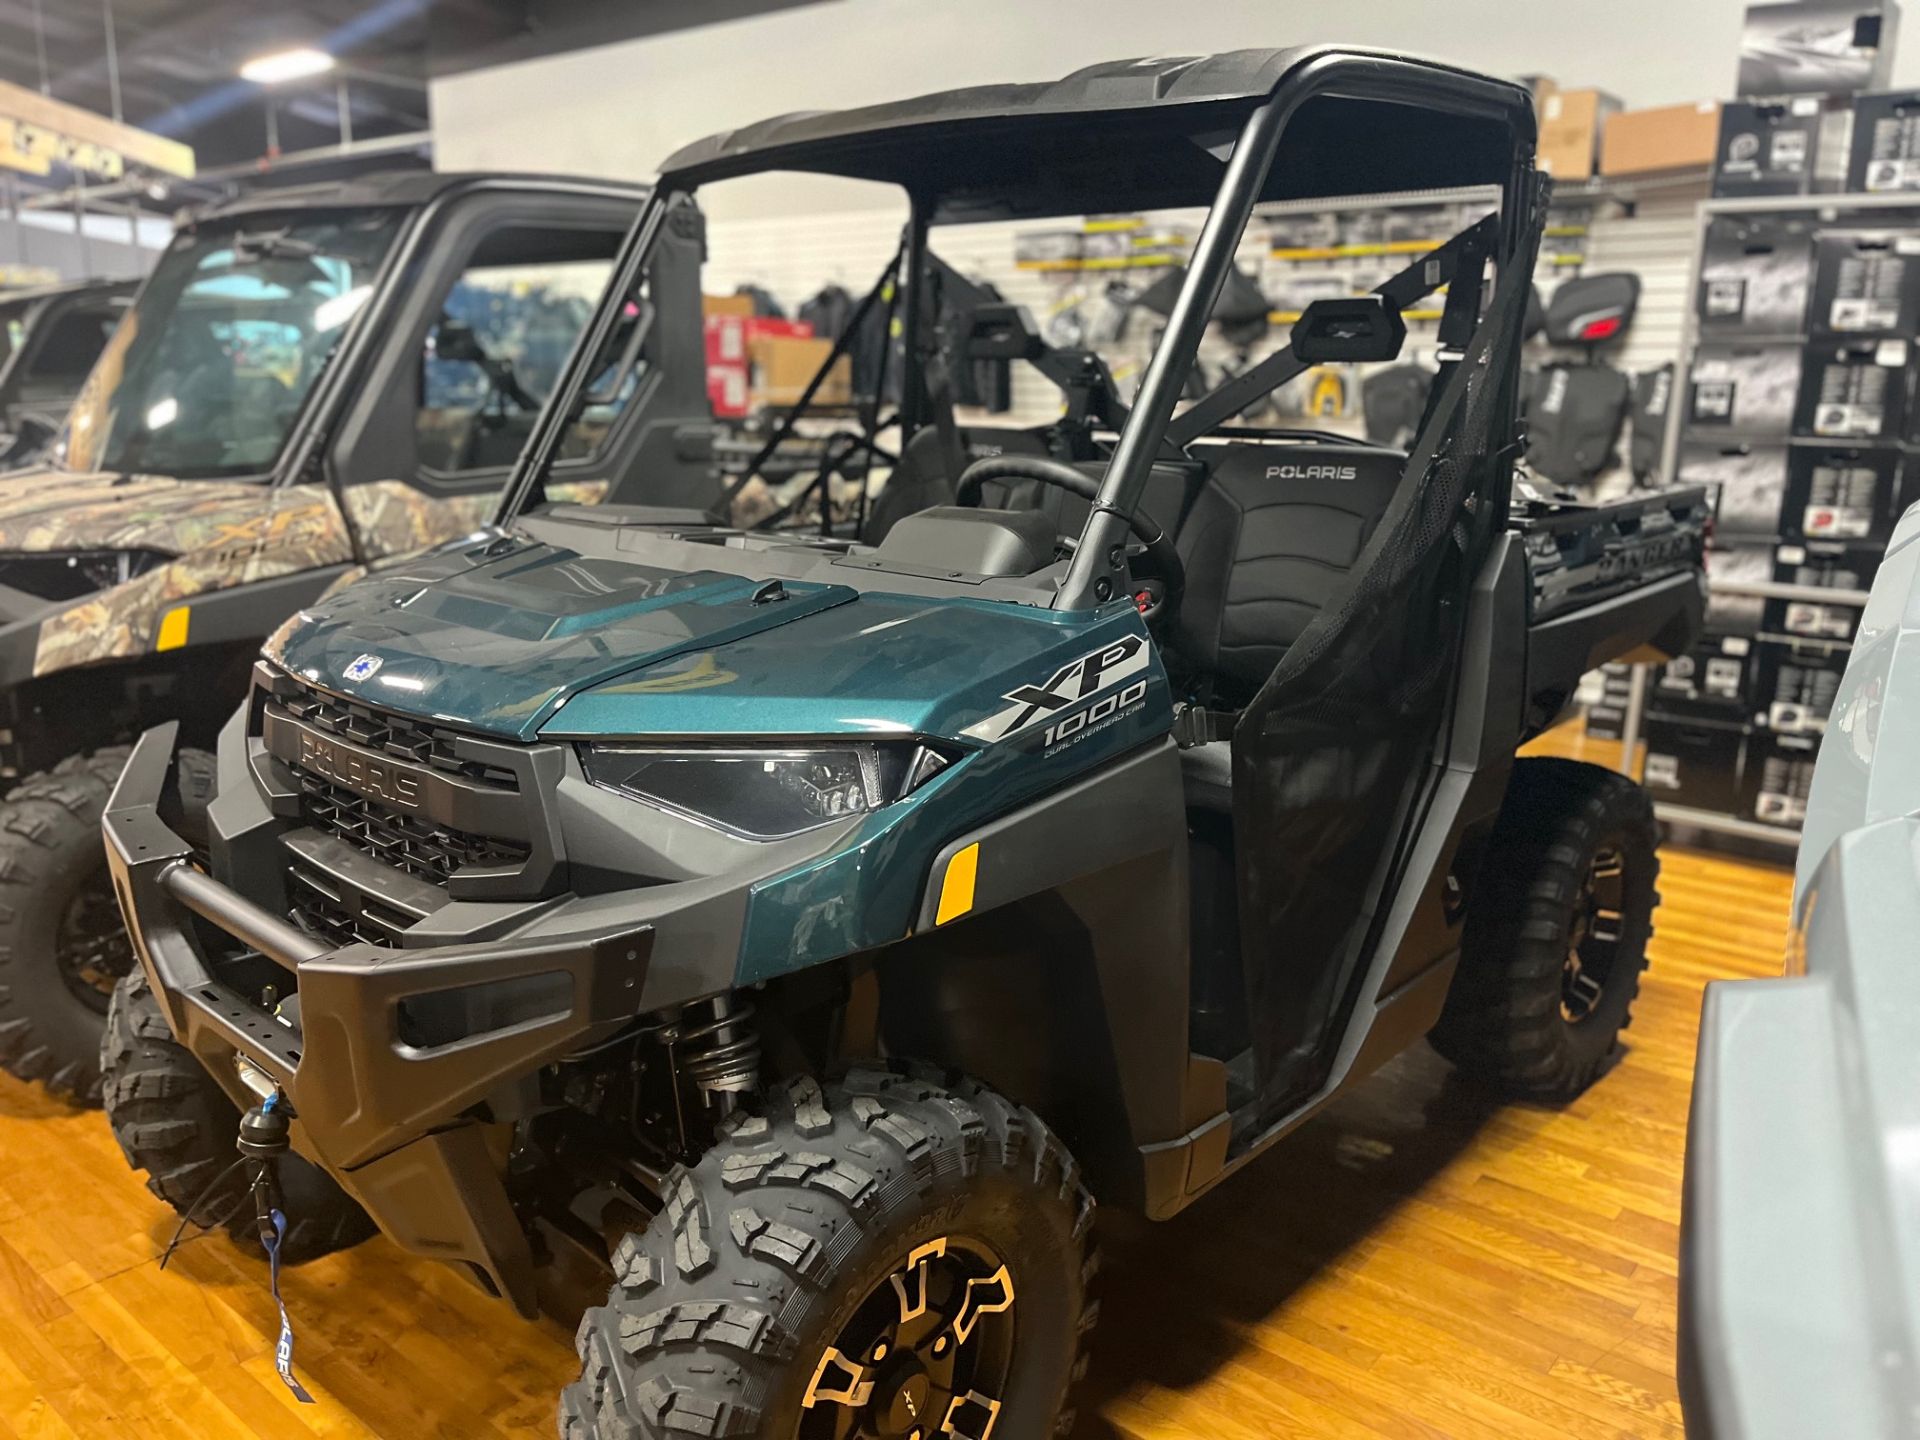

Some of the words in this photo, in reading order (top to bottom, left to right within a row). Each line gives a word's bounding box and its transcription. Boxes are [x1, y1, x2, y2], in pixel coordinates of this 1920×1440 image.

[1265, 465, 1357, 480] POLARIS
[997, 633, 1144, 740] XP
[1044, 679, 1147, 747] 1000
[301, 731, 420, 808] POLARIS
[903, 1390, 916, 1417] XP
